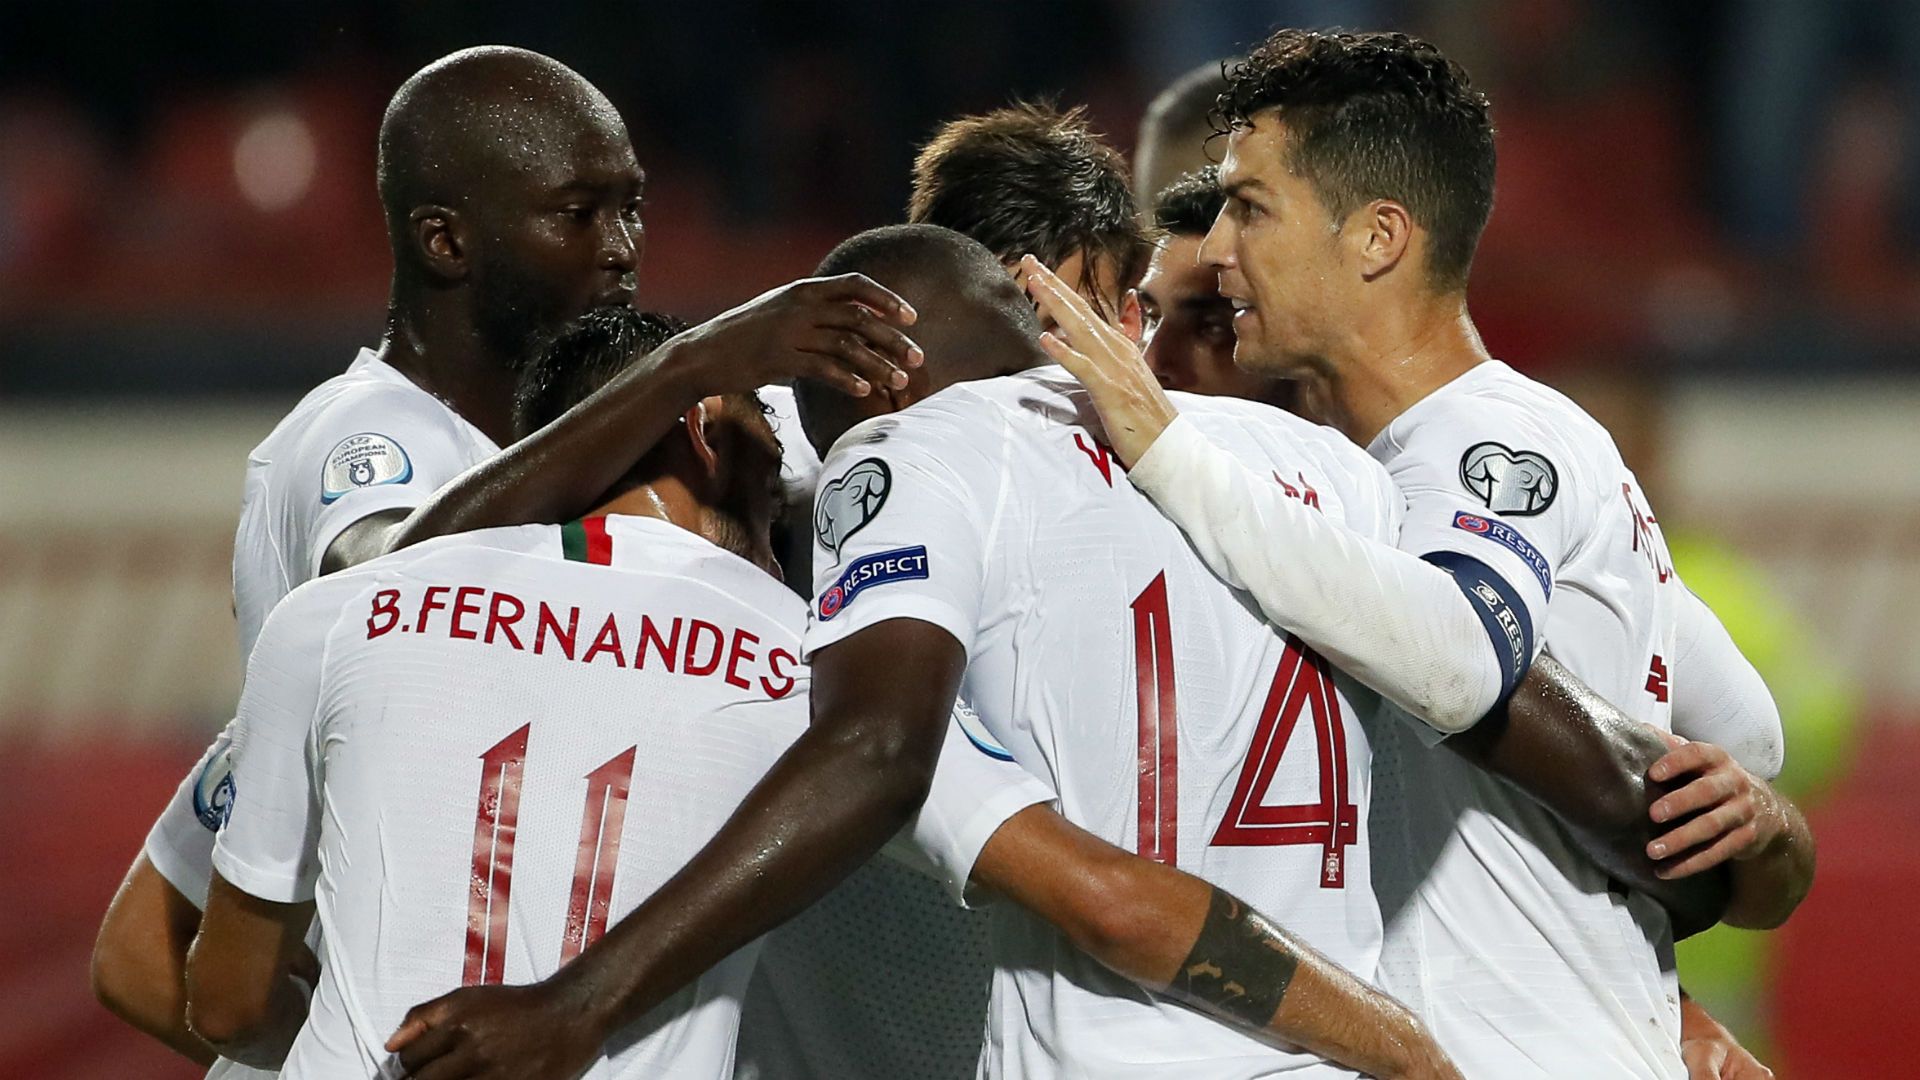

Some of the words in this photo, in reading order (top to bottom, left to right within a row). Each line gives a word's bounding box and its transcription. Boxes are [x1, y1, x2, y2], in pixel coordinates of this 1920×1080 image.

[332, 444, 386, 464] EUROPEAN
[333, 450, 387, 469] CHAMPIONS
[843, 555, 925, 596] RESPECT
[367, 586, 797, 699] B.FERNANDES
[1130, 568, 1358, 888] 14
[462, 722, 637, 987] 11
